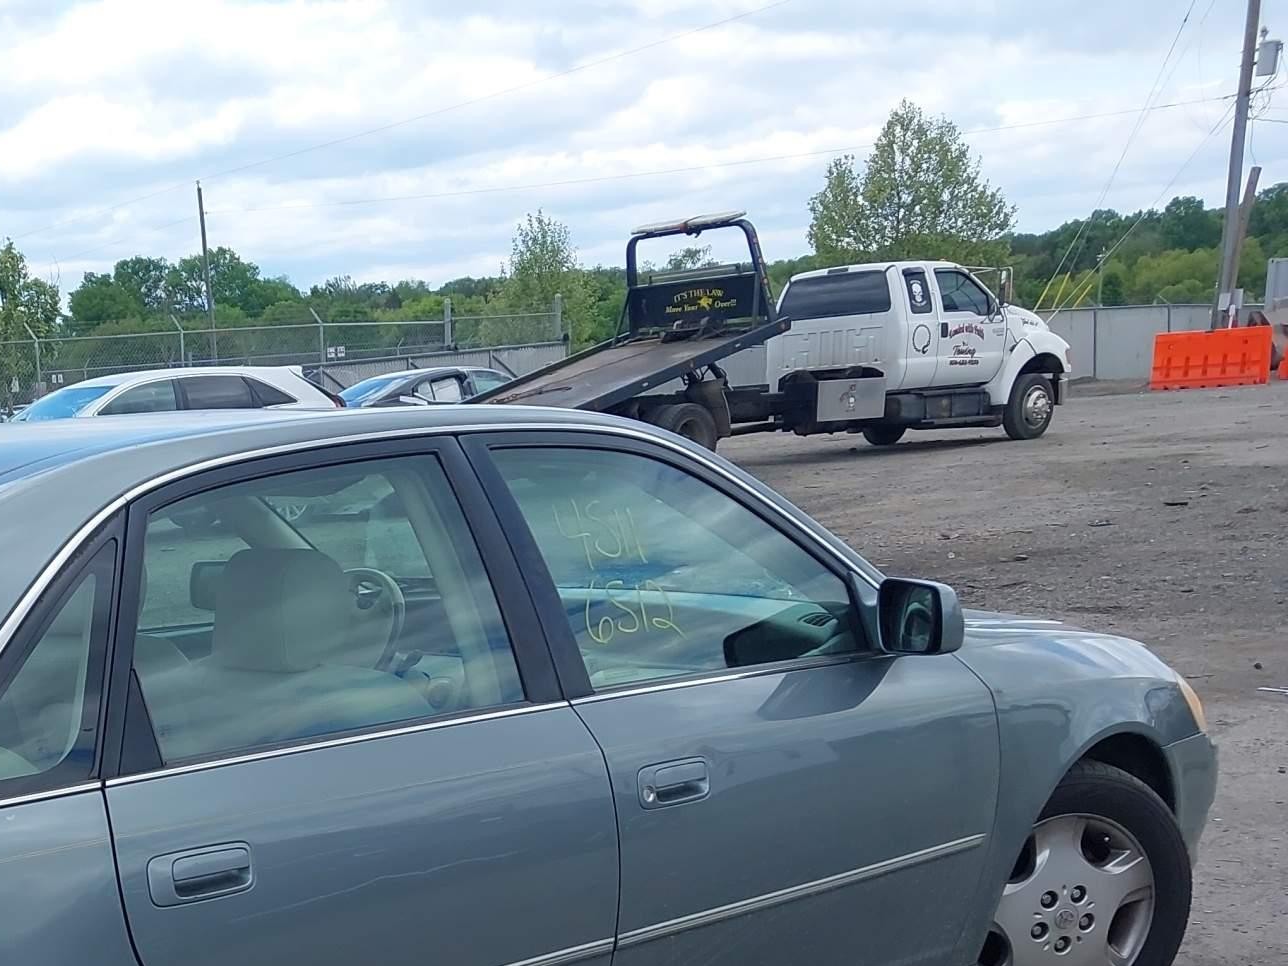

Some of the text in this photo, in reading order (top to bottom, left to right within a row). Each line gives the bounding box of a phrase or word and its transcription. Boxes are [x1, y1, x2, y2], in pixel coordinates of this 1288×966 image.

[689, 288, 705, 298] THE
[706, 288, 723, 297] LAW
[585, 579, 688, 644] 6512
